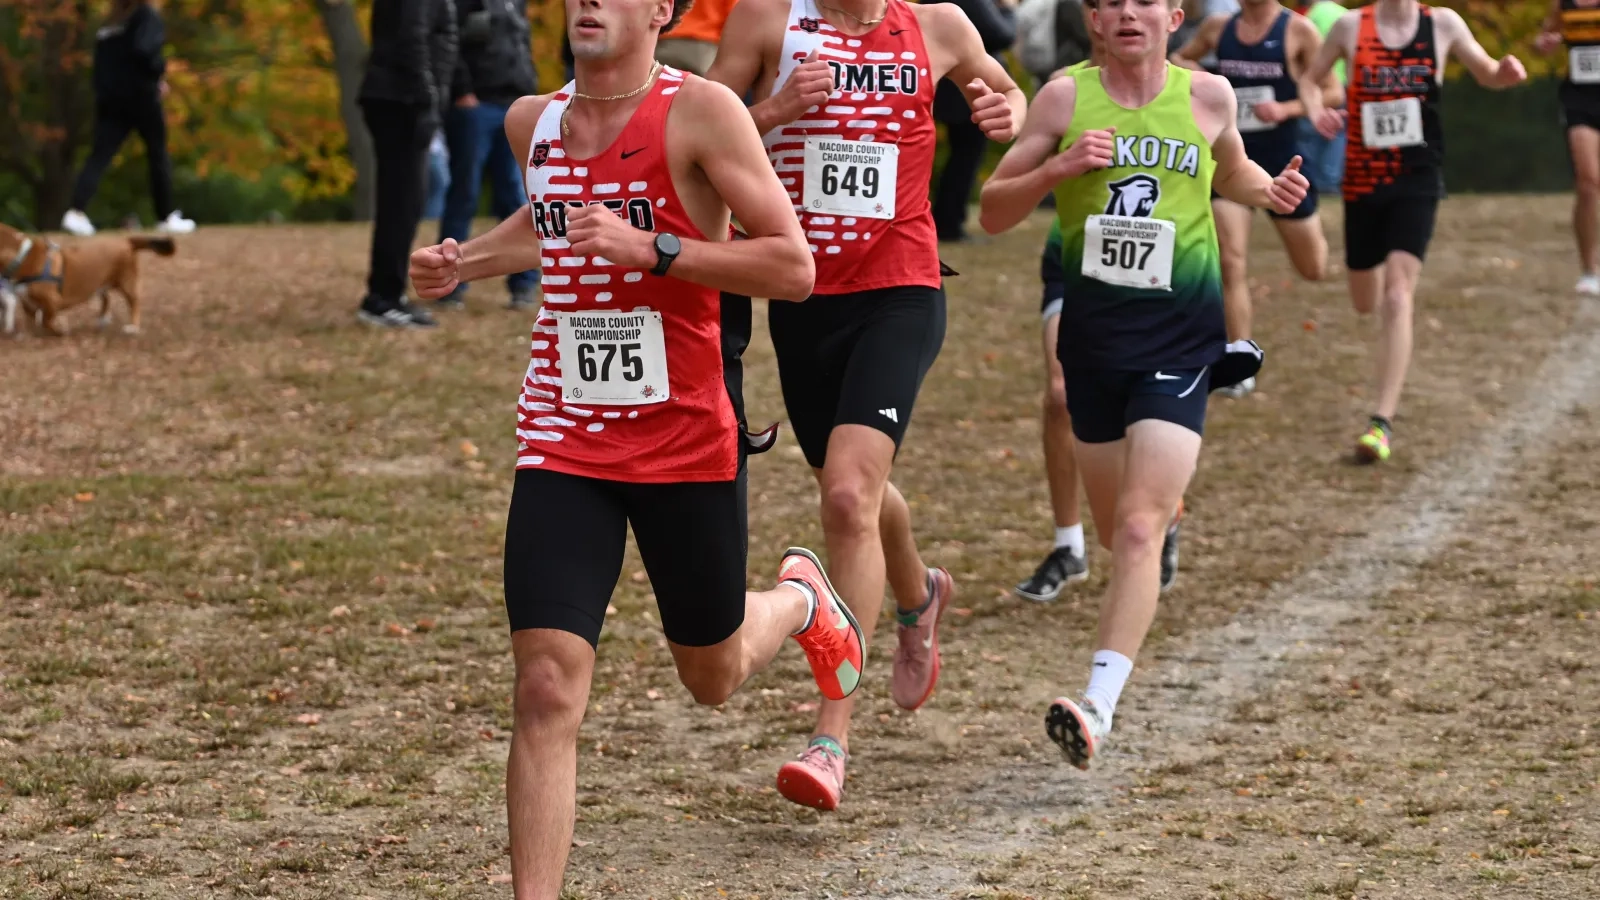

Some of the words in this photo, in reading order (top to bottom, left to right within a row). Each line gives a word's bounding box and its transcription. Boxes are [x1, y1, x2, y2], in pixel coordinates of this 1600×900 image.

[799, 59, 918, 94] OMEO
[535, 147, 546, 160] R
[819, 142, 854, 153] MACOMB
[856, 144, 885, 155] COUNTY
[822, 152, 881, 165] CHAMPIONSHIP
[1106, 135, 1200, 178] KOTA
[821, 163, 880, 199] 649
[533, 197, 655, 239] ROO
[1100, 217, 1132, 229] MACOMB
[1134, 219, 1163, 231] COUNTY
[1102, 227, 1159, 240] CHAMPIONSHIP
[1101, 239, 1156, 271] 507
[570, 316, 606, 328] MACOMB
[608, 316, 645, 328] COUNTY
[574, 328, 641, 341] CHAMPIONSHIP
[577, 343, 644, 382] 675
